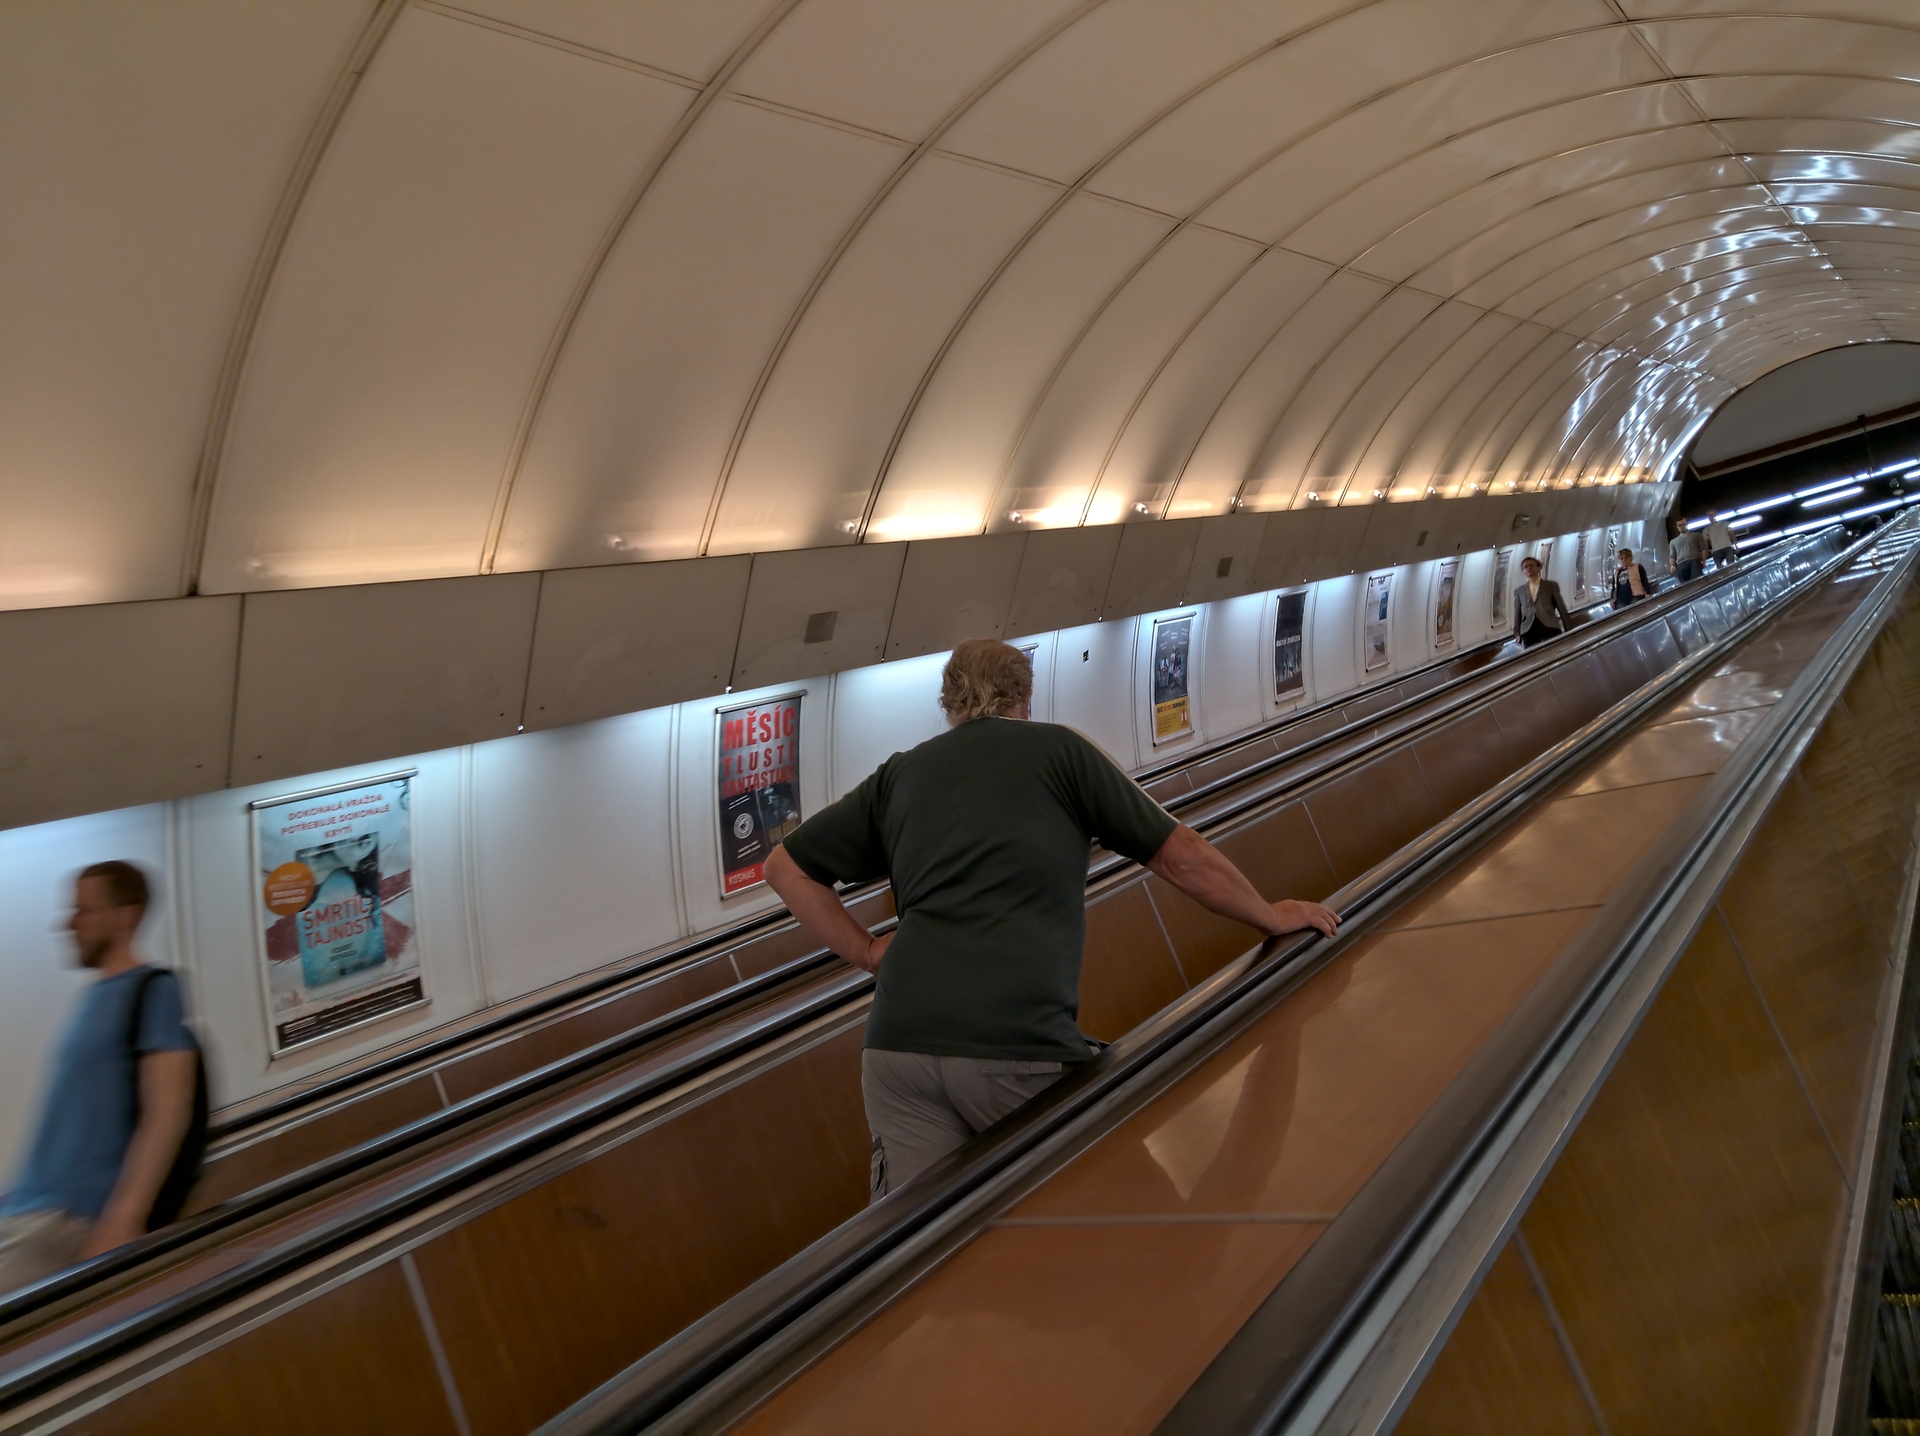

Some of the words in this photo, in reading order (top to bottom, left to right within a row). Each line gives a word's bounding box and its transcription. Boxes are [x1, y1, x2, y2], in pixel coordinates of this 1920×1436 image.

[724, 704, 796, 752] MĚSÍC
[722, 738, 796, 777] TLUSTÉ
[722, 764, 796, 800] FANTASTIKY
[281, 816, 337, 835] POTŘEBUJE
[287, 800, 343, 821] DOKONALÁ
[345, 794, 384, 808] VRAŽDA
